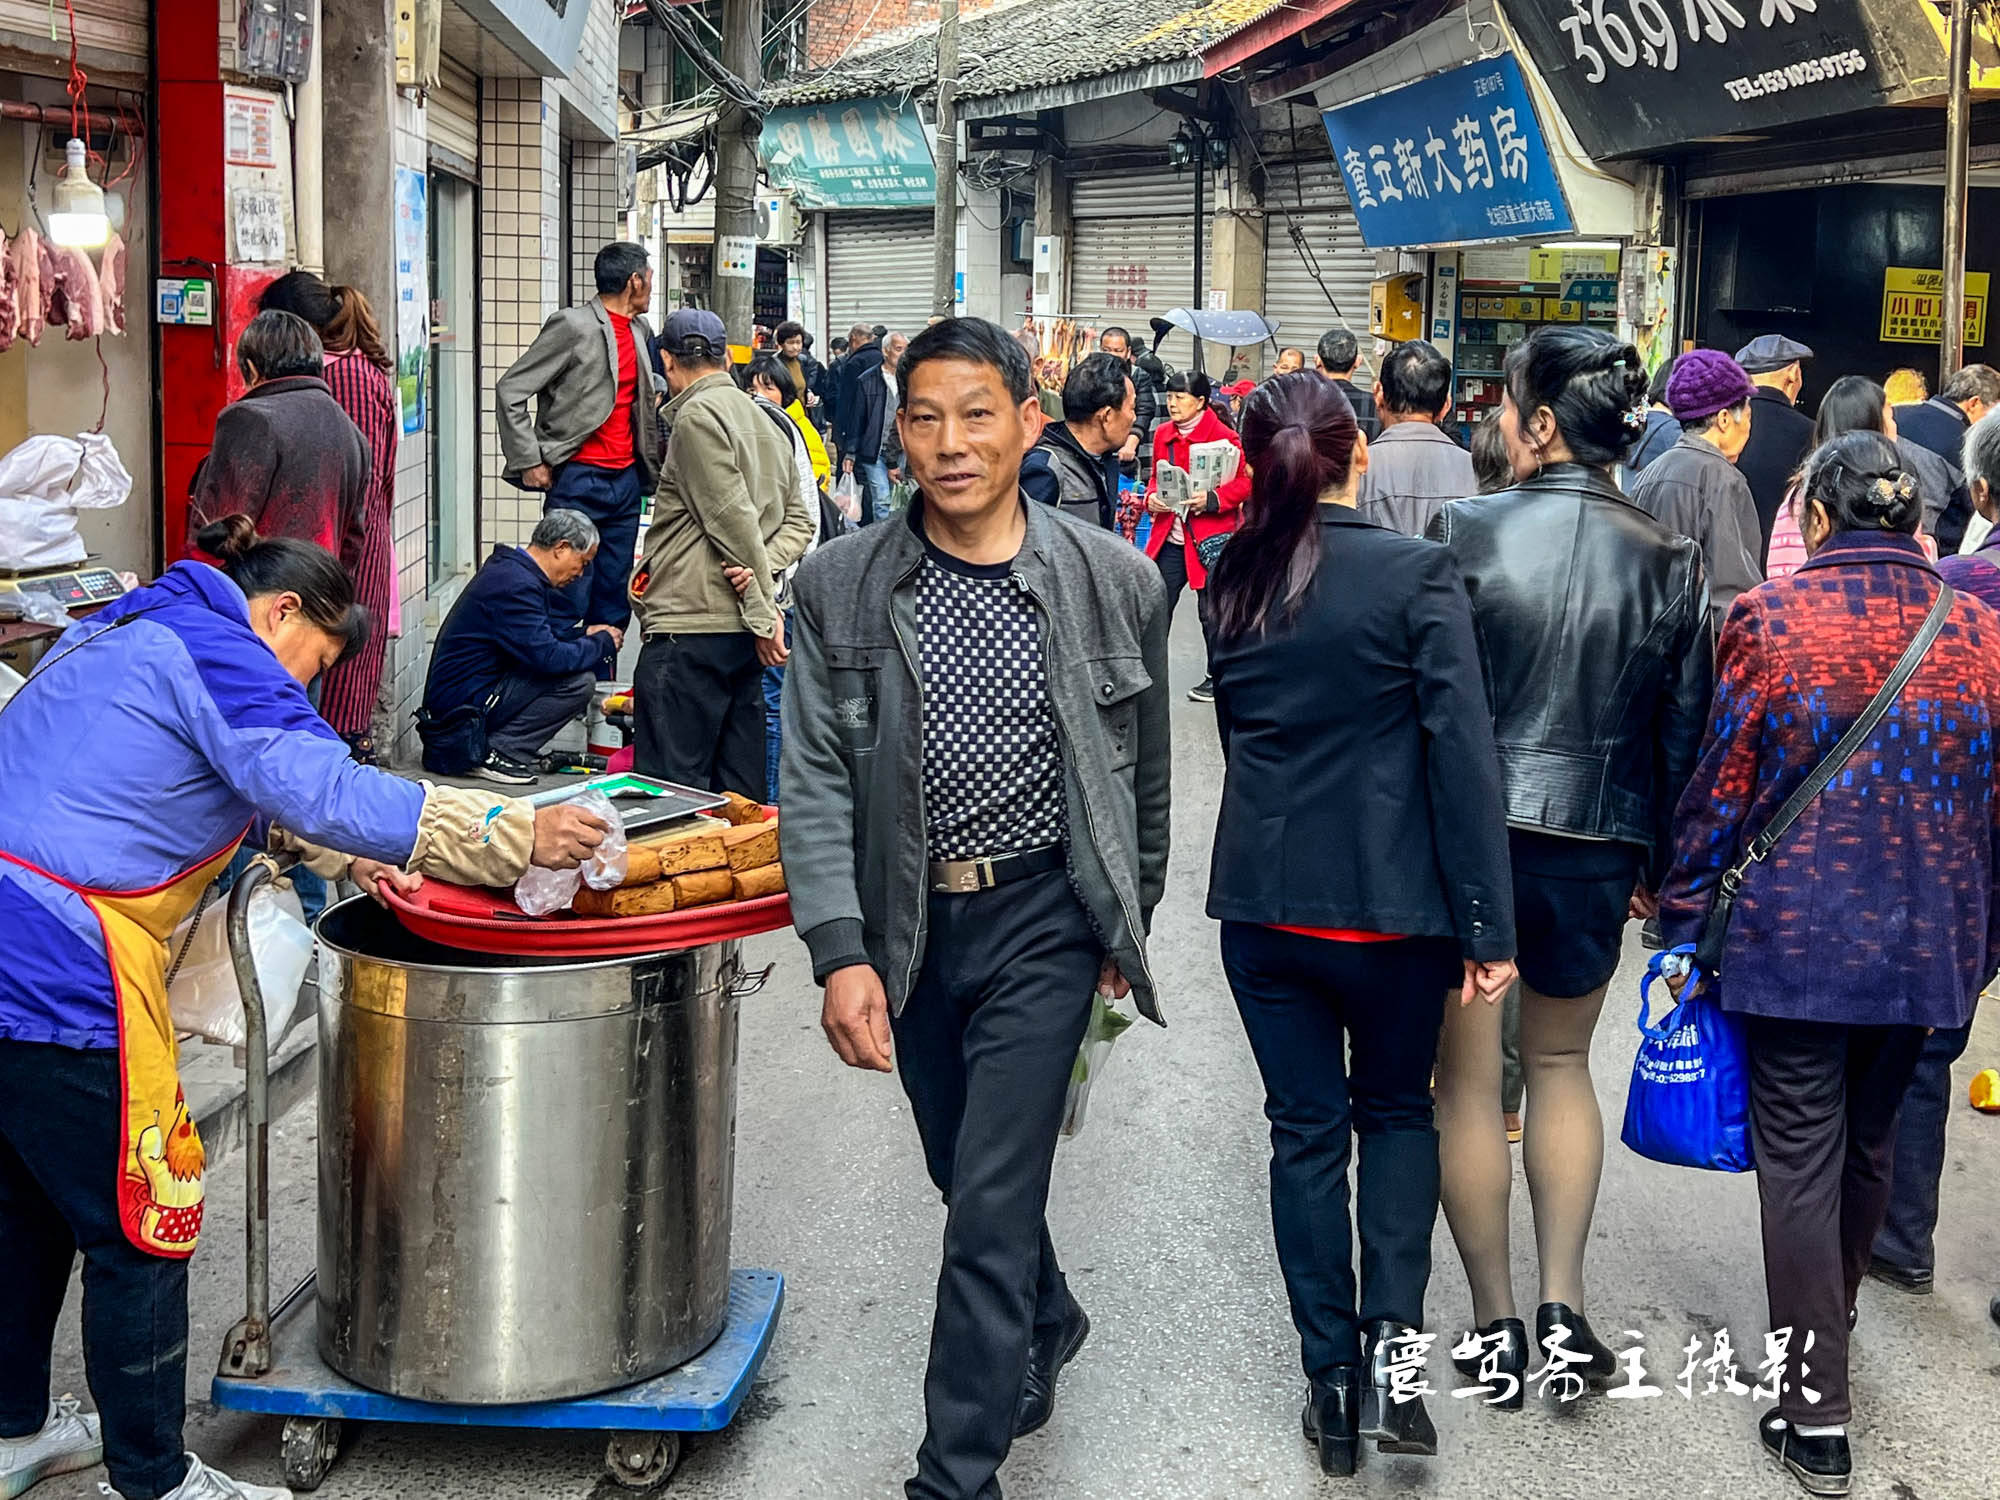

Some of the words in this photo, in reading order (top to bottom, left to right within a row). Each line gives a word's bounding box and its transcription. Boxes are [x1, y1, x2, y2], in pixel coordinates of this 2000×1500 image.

[1724, 48, 1867, 101] TEL:15310269756
[1344, 105, 1528, 209] 童立新大药房
[240, 227, 279, 248] 禁止入内
